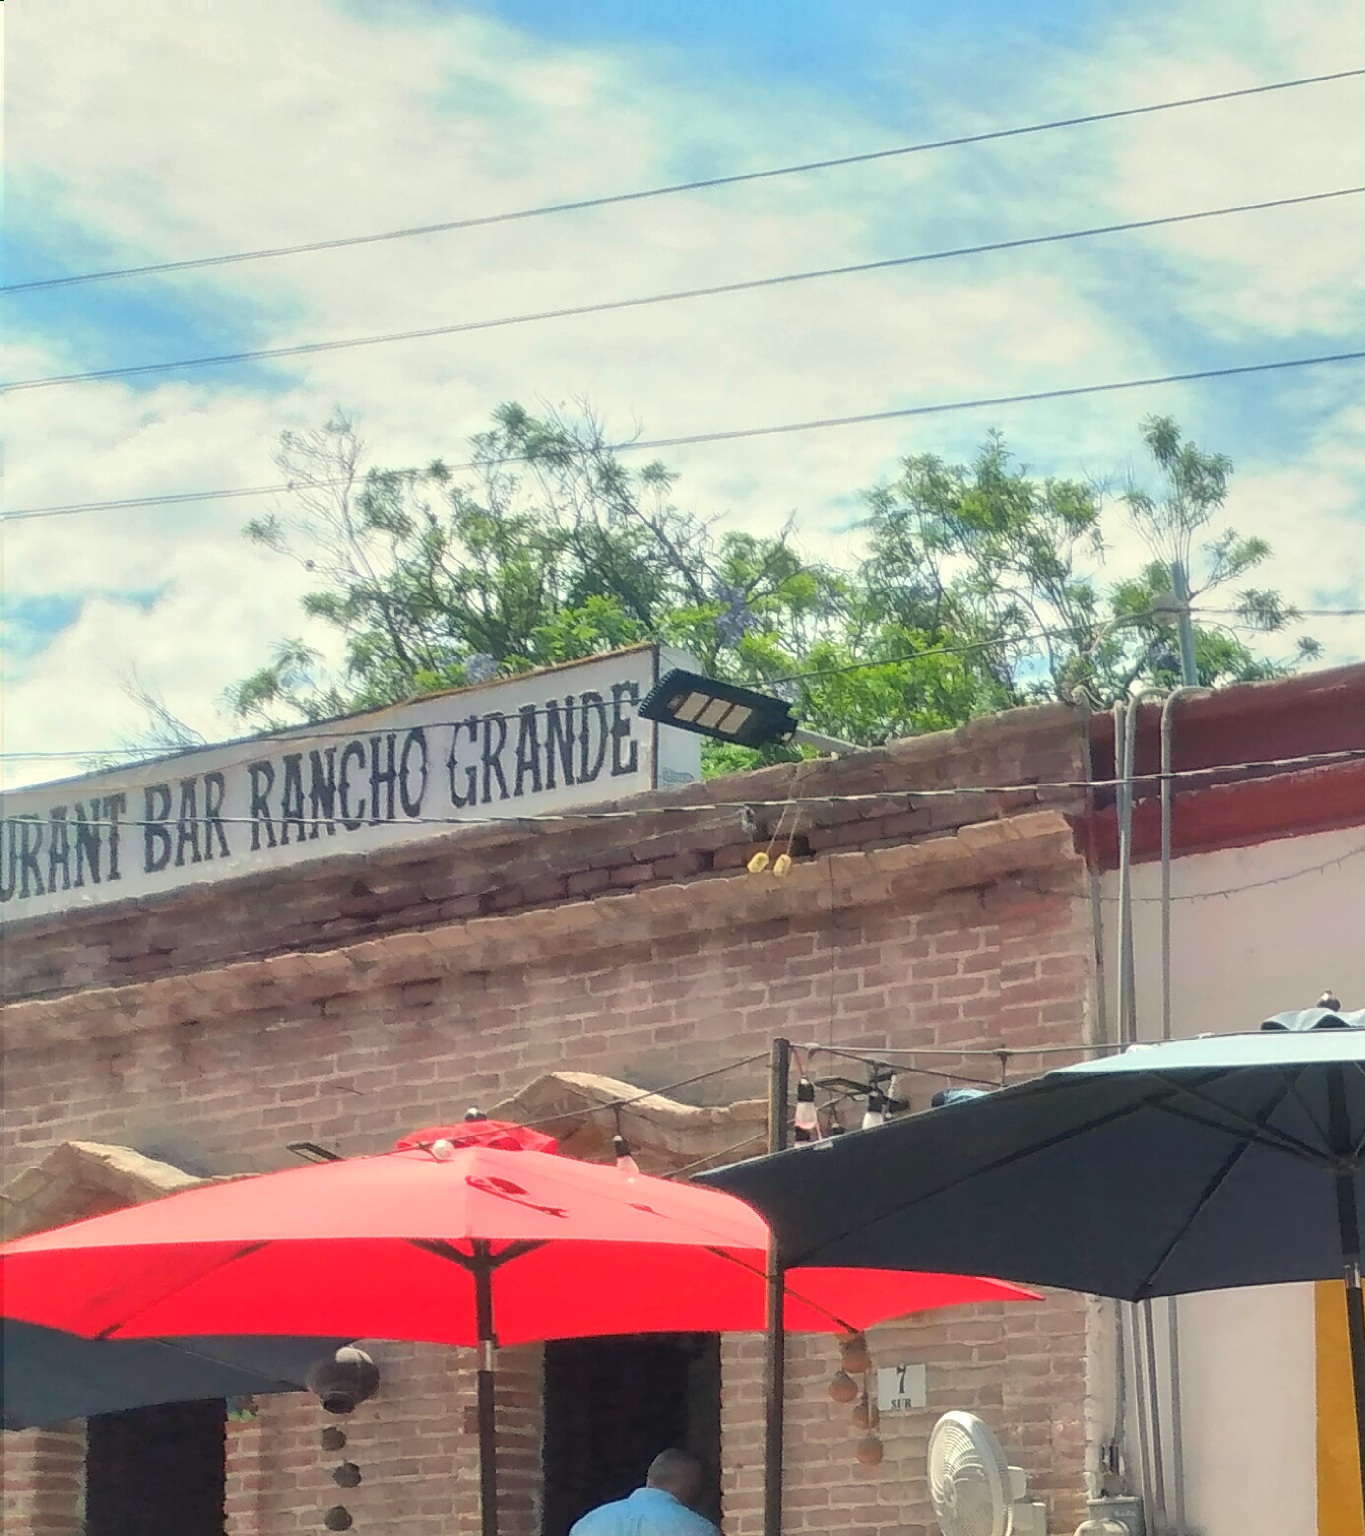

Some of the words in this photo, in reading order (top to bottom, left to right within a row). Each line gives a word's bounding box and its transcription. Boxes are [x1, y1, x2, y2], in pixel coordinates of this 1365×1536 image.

[144, 771, 231, 874] BAR
[247, 725, 430, 851] RANCHO
[447, 679, 642, 810] GRANDE
[896, 1363, 907, 1394] 7
[891, 1398, 912, 1410] SUR
